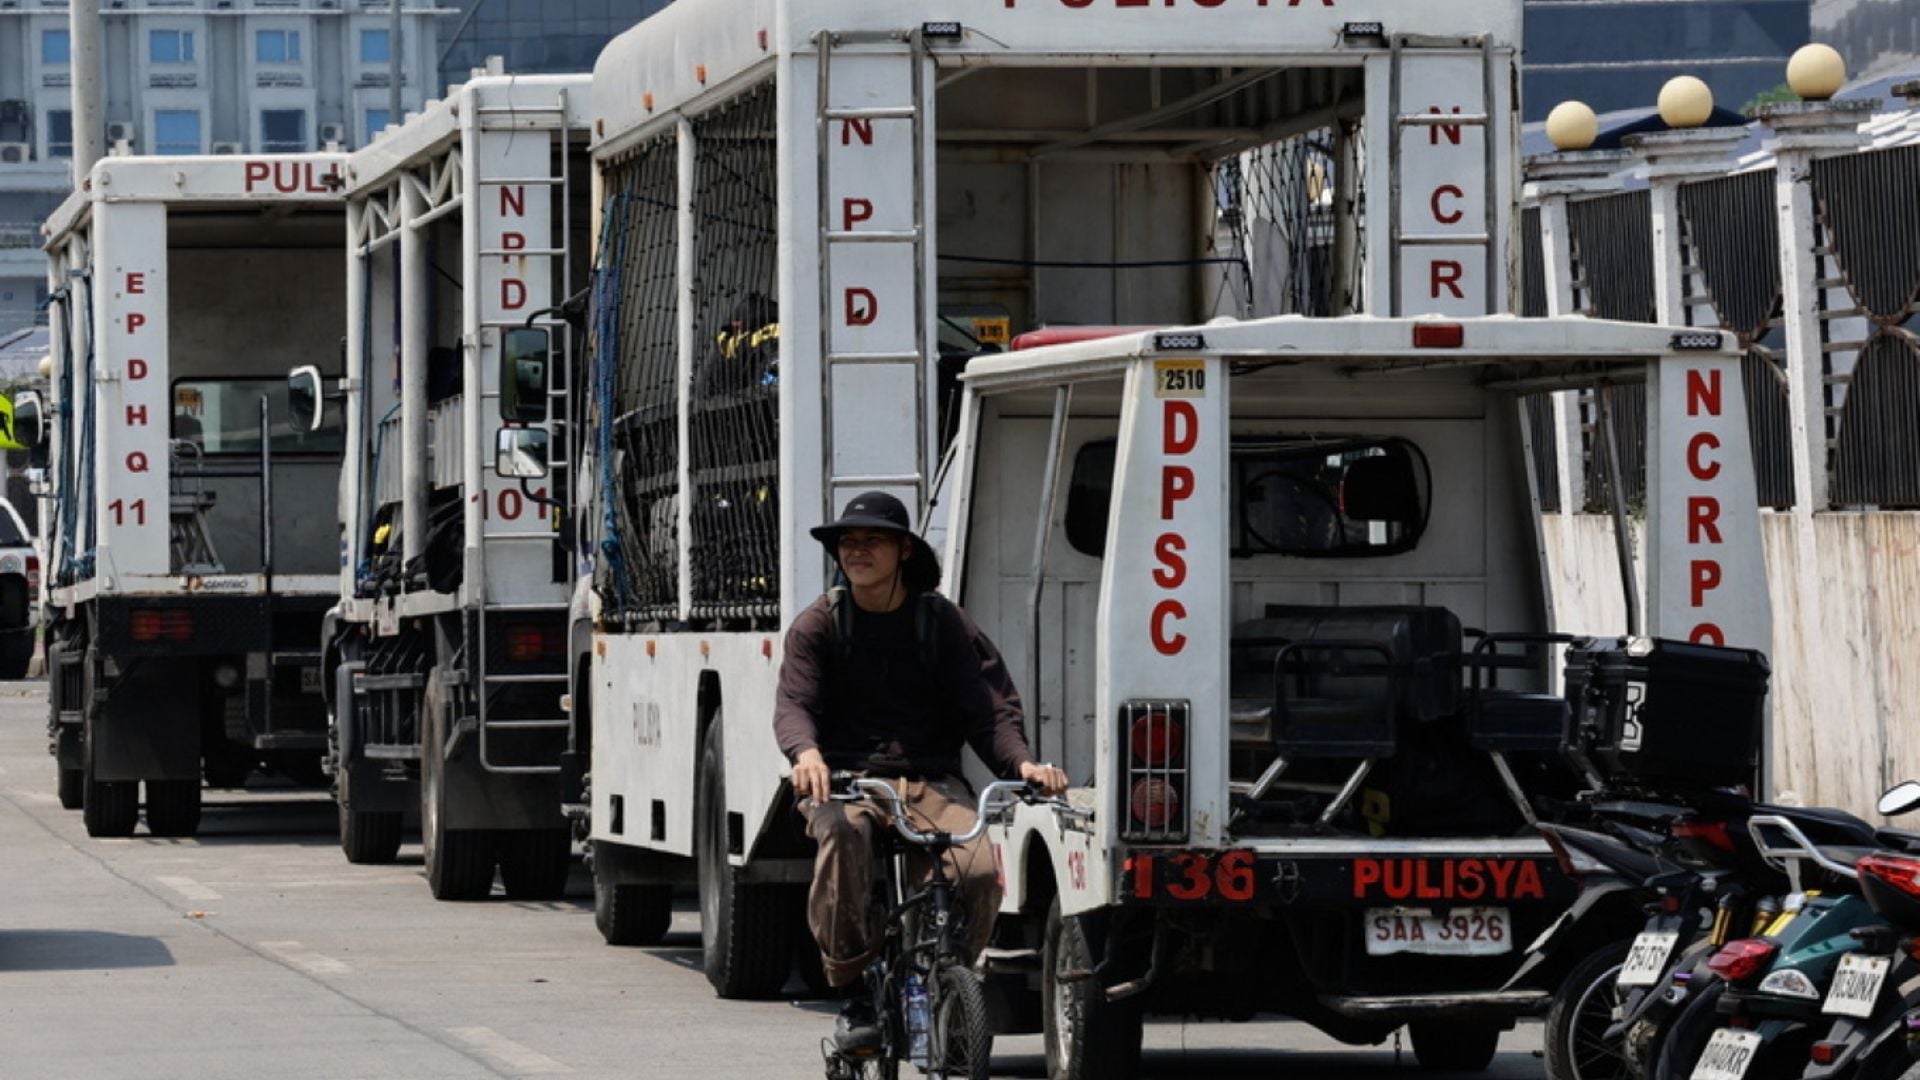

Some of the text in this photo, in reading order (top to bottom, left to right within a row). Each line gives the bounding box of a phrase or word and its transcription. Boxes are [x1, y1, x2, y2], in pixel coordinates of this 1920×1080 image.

[842, 117, 878, 327] NPD
[1429, 106, 1464, 299] NCR
[500, 184, 527, 310] NPD
[126, 272, 149, 473] EPDHQ
[1166, 369, 1205, 390] 2510
[108, 498, 145, 526] 11
[471, 487, 547, 521] 101
[1150, 400, 1199, 656] DPSC
[1122, 849, 1256, 901] 136
[1353, 858, 1545, 899] PULISYA
[1374, 913, 1504, 942] SAA 3926
